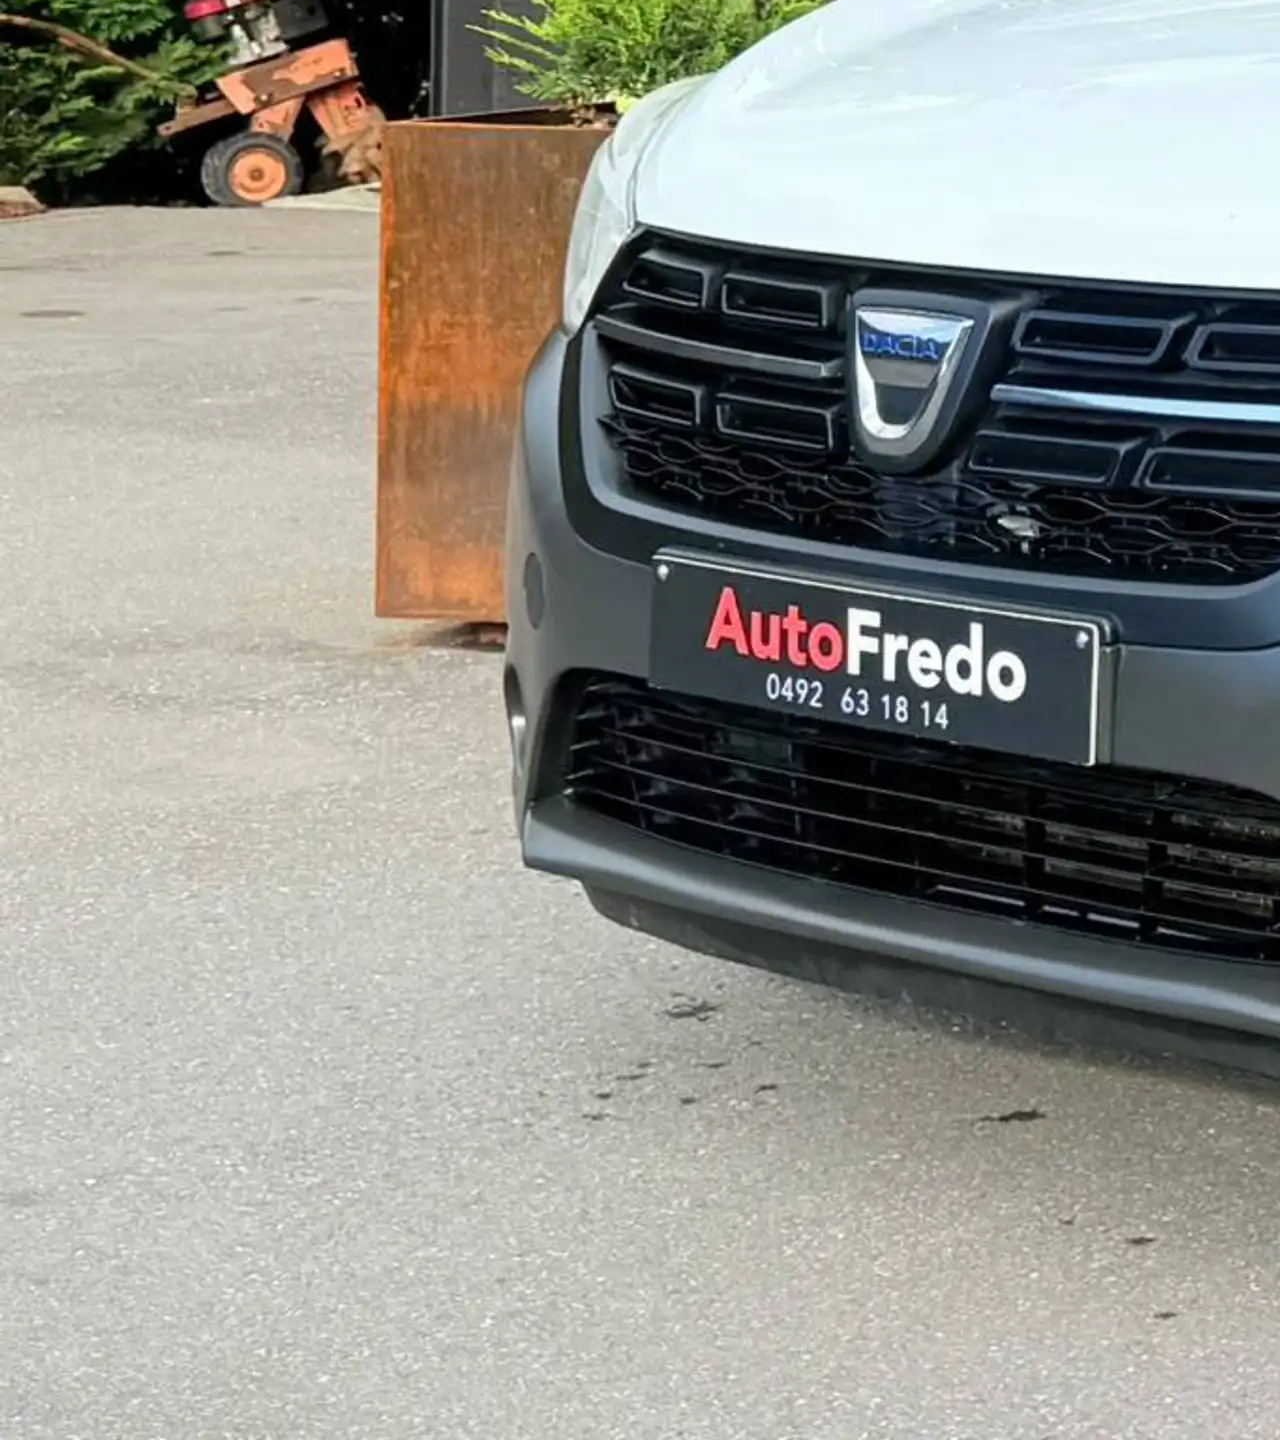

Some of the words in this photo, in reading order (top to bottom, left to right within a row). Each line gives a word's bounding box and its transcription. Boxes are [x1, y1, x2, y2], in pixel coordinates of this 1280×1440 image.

[766, 673, 824, 709] 0492
[840, 688, 869, 717] 63
[881, 695, 909, 724] 18
[921, 702, 949, 731] 14
